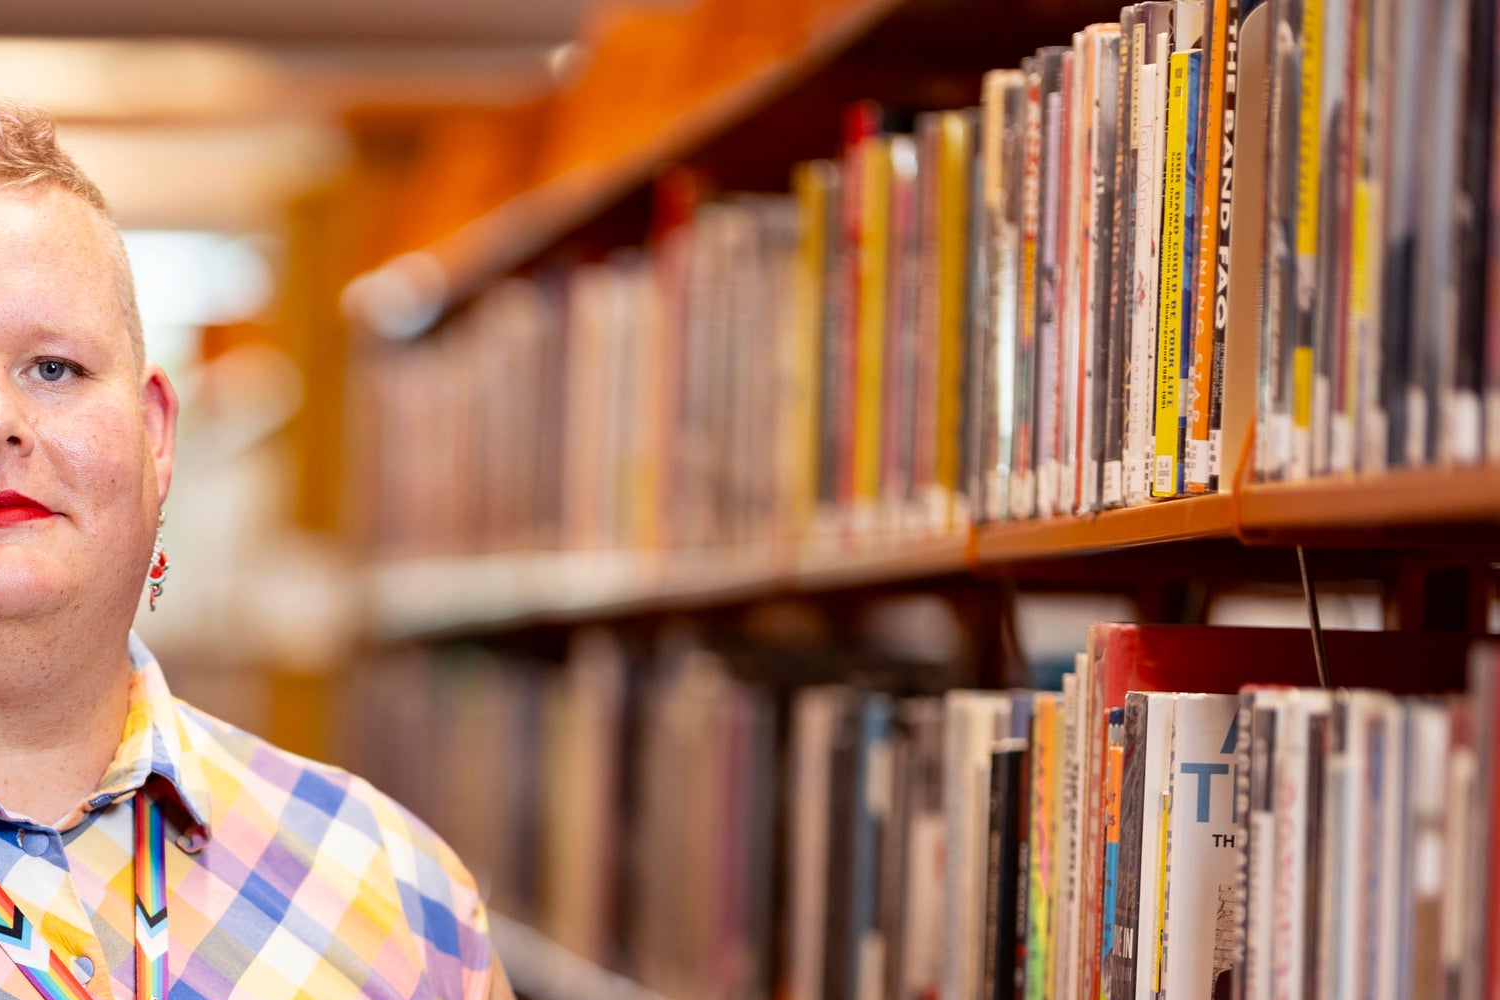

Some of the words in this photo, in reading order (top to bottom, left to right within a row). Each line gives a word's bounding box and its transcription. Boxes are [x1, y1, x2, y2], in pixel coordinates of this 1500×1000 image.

[1132, 33, 1140, 141] BROTHERS
[1225, 17, 1239, 93] THE
[1139, 120, 1153, 162] Tori
[1220, 109, 1235, 231] BAND
[1138, 174, 1151, 240] Amos
[1197, 205, 1211, 335] SHINING
[1214, 244, 1230, 331] FAQ
[1166, 375, 1174, 408] LIFE
[1192, 352, 1203, 423] STAR
